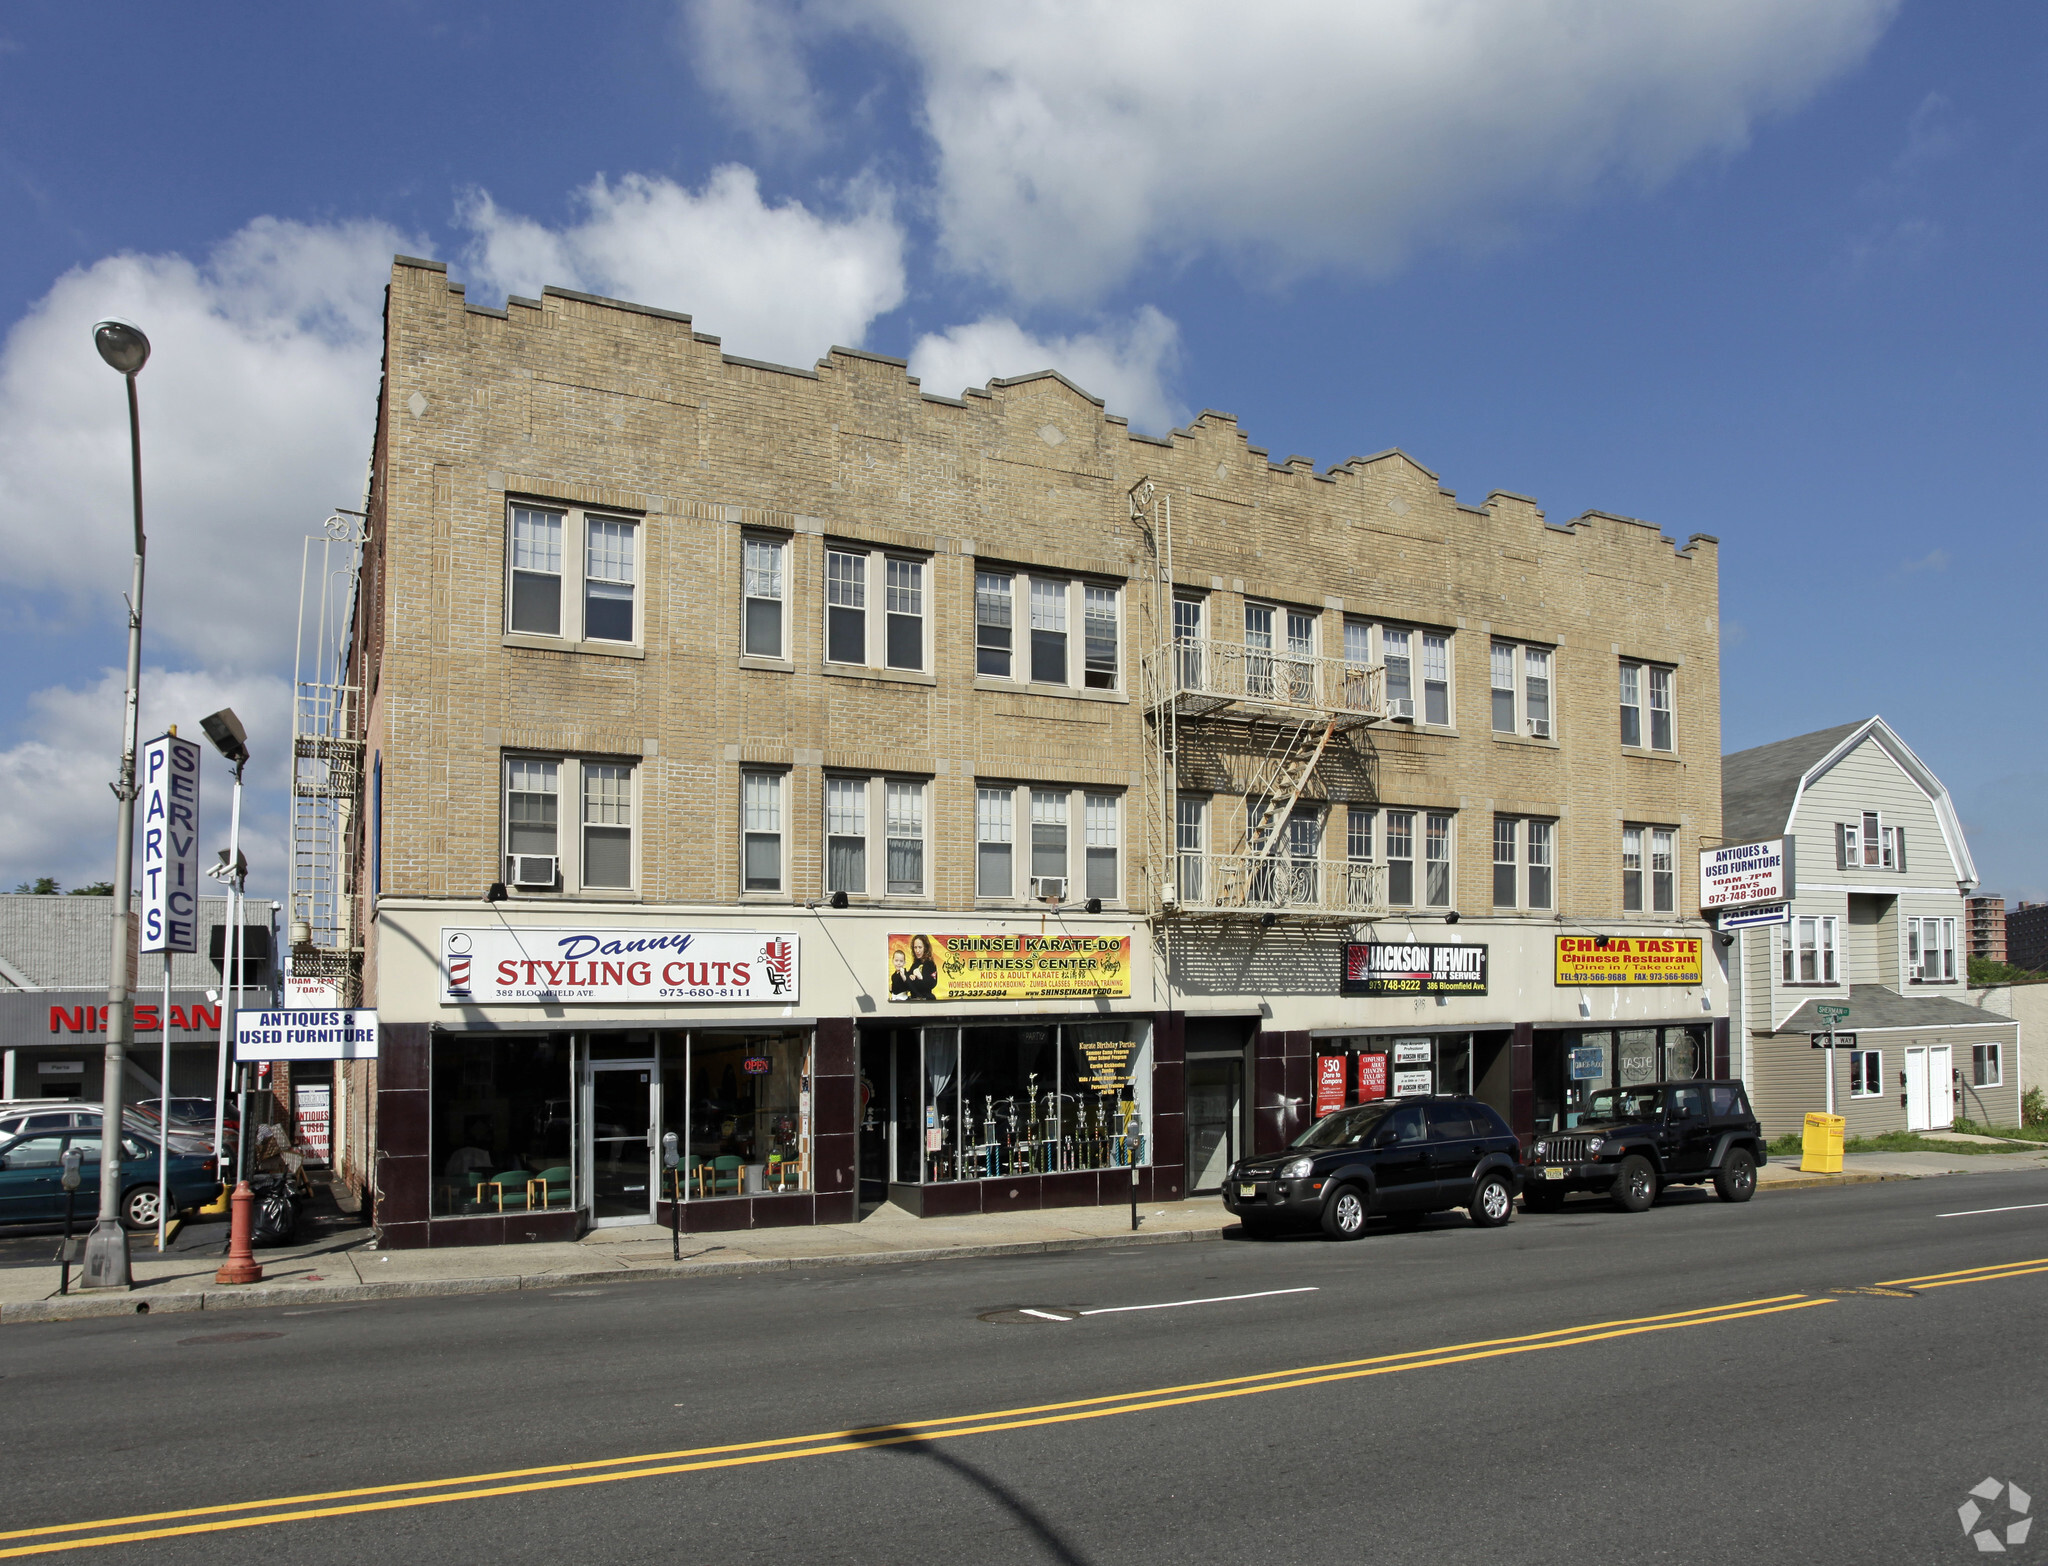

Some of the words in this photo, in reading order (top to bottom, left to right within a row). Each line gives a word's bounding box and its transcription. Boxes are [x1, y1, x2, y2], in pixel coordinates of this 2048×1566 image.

[146, 749, 165, 941] PARTS
[167, 745, 196, 946] SERVICE
[1715, 845, 1760, 862] ANTIQUES
[1762, 845, 1769, 855] &
[1705, 864, 1728, 877] USED
[1730, 855, 1781, 874] FURNITURE
[1712, 876, 1742, 886] 10AM
[1731, 881, 1760, 891] DAYS
[1708, 886, 1777, 904] 973-748-3000
[1723, 906, 1784, 920] PARKING
[558, 934, 696, 960] Danny
[947, 938, 1020, 951] SHINSEI
[1025, 938, 1121, 951] KARATE-DO
[1636, 940, 1698, 953] TASTE
[969, 959, 1034, 970] FITNESS
[1039, 959, 1098, 969] CENTER
[1370, 946, 1430, 971] JACKSON
[1433, 948, 1483, 971] HEWITT
[1562, 954, 1620, 963] Chinese
[1623, 954, 1696, 963] Restaurant
[495, 960, 651, 986] STYLING
[662, 961, 751, 987] CUTS
[980, 971, 998, 979] KIDS
[1007, 971, 1030, 979] ADULT
[1032, 971, 1059, 979] KARATE
[1432, 971, 1447, 979] TAX
[1449, 971, 1481, 979] SERVICE
[1634, 973, 1648, 981] FAX:
[948, 981, 972, 989] WOMENS
[973, 981, 992, 989] CARDIO
[1030, 980, 1047, 988] ZUMBA
[1048, 980, 1070, 988] CLASSES
[1368, 981, 1381, 990] 973
[1383, 980, 1421, 990] 748-9222
[1440, 982, 1472, 990] Bloomfield
[1473, 982, 1486, 990] Ave.
[659, 988, 751, 997] 973-680-8111
[948, 989, 1007, 997] 973-337-5994
[259, 1012, 339, 1027] ANTIQUES
[343, 1013, 355, 1026] &
[239, 1030, 282, 1044] USED
[286, 1029, 374, 1044] FURNITURE
[1079, 1042, 1096, 1050] Karate
[1096, 1041, 1118, 1049] Birthday
[744, 1060, 769, 1071] OPEN
[1324, 1059, 1340, 1072] $50
[295, 1110, 329, 1122] ANTIQUES
[306, 1122, 324, 1133] USED
